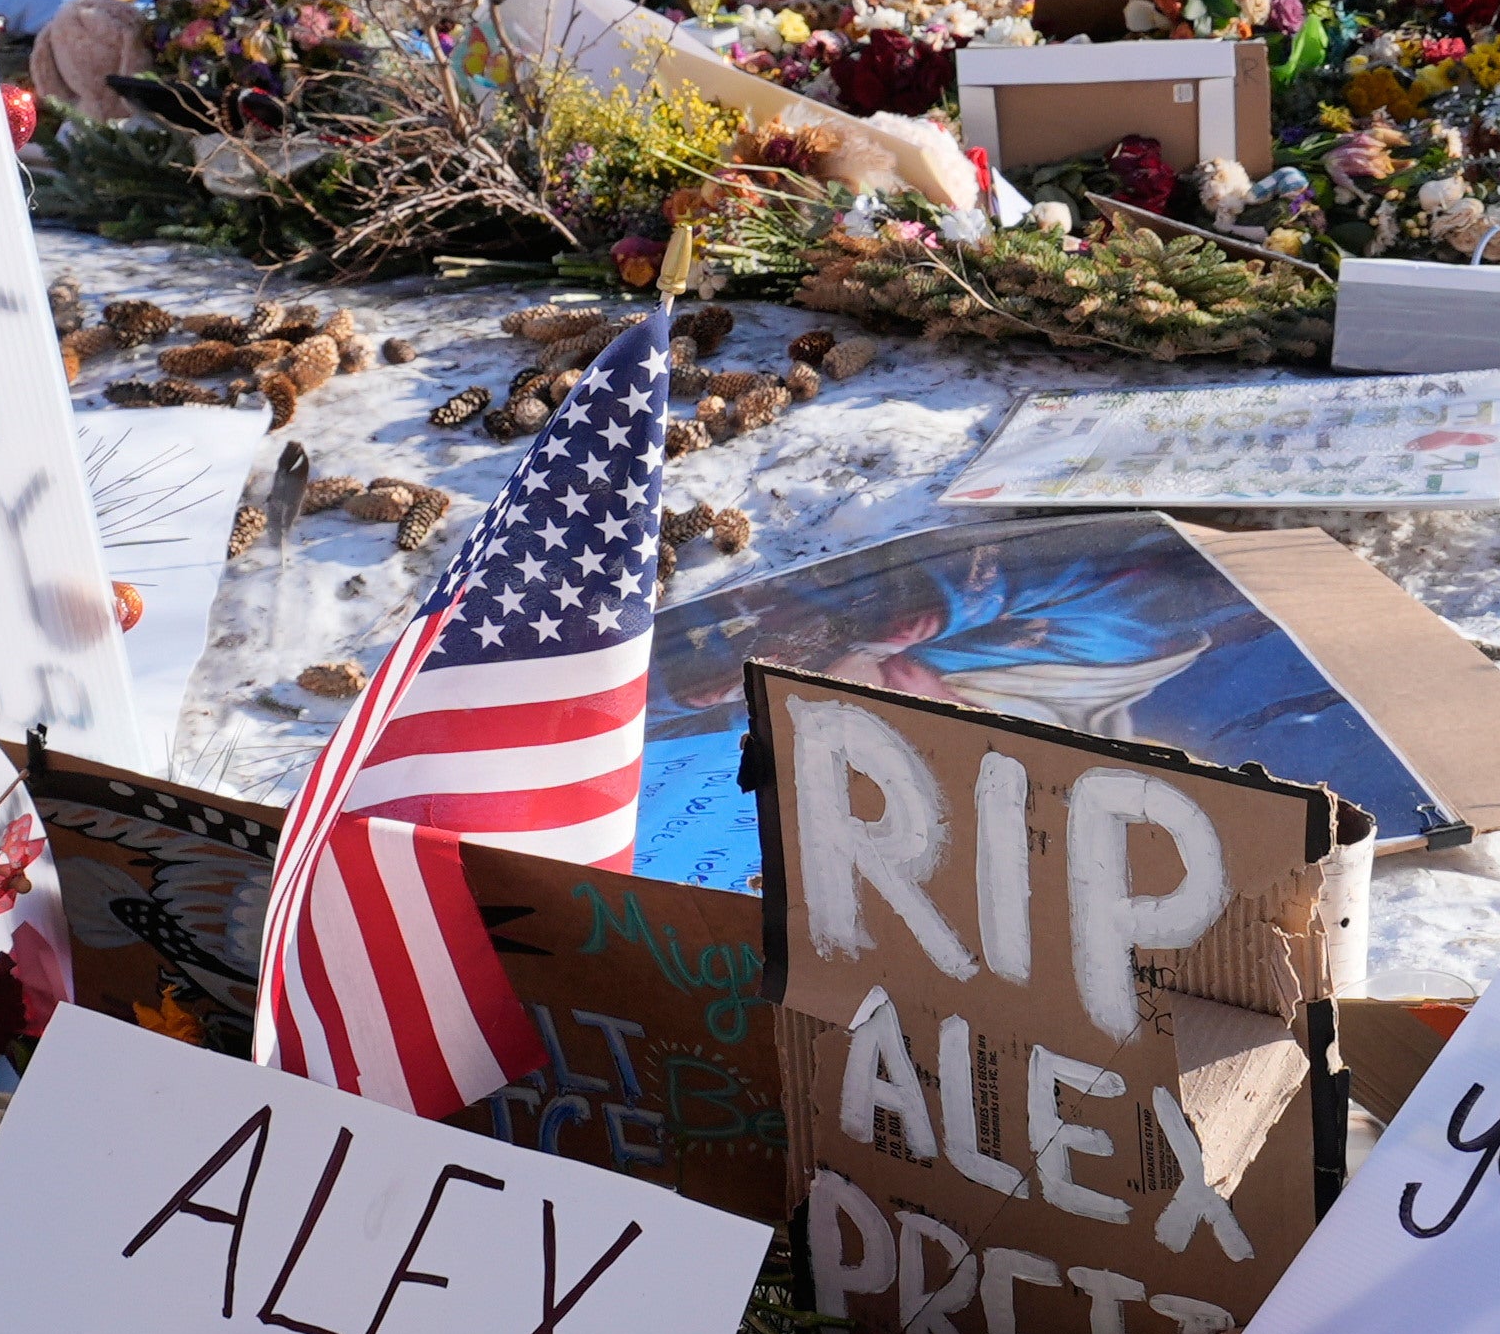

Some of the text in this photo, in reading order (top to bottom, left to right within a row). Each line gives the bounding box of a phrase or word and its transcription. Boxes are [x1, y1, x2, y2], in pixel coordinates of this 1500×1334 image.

[1132, 400, 1495, 433] FREEDOM
[787, 693, 1232, 1049] RIP
[976, 1049, 989, 1081] DESIGN
[977, 1089, 991, 1107] and
[837, 985, 1257, 1264] ALEX
[888, 1113, 901, 1138] BOX
[977, 1107, 991, 1136] SERIES
[874, 1131, 888, 1155] THE
[1143, 1108, 1158, 1192] GUARANTEE STAMP
